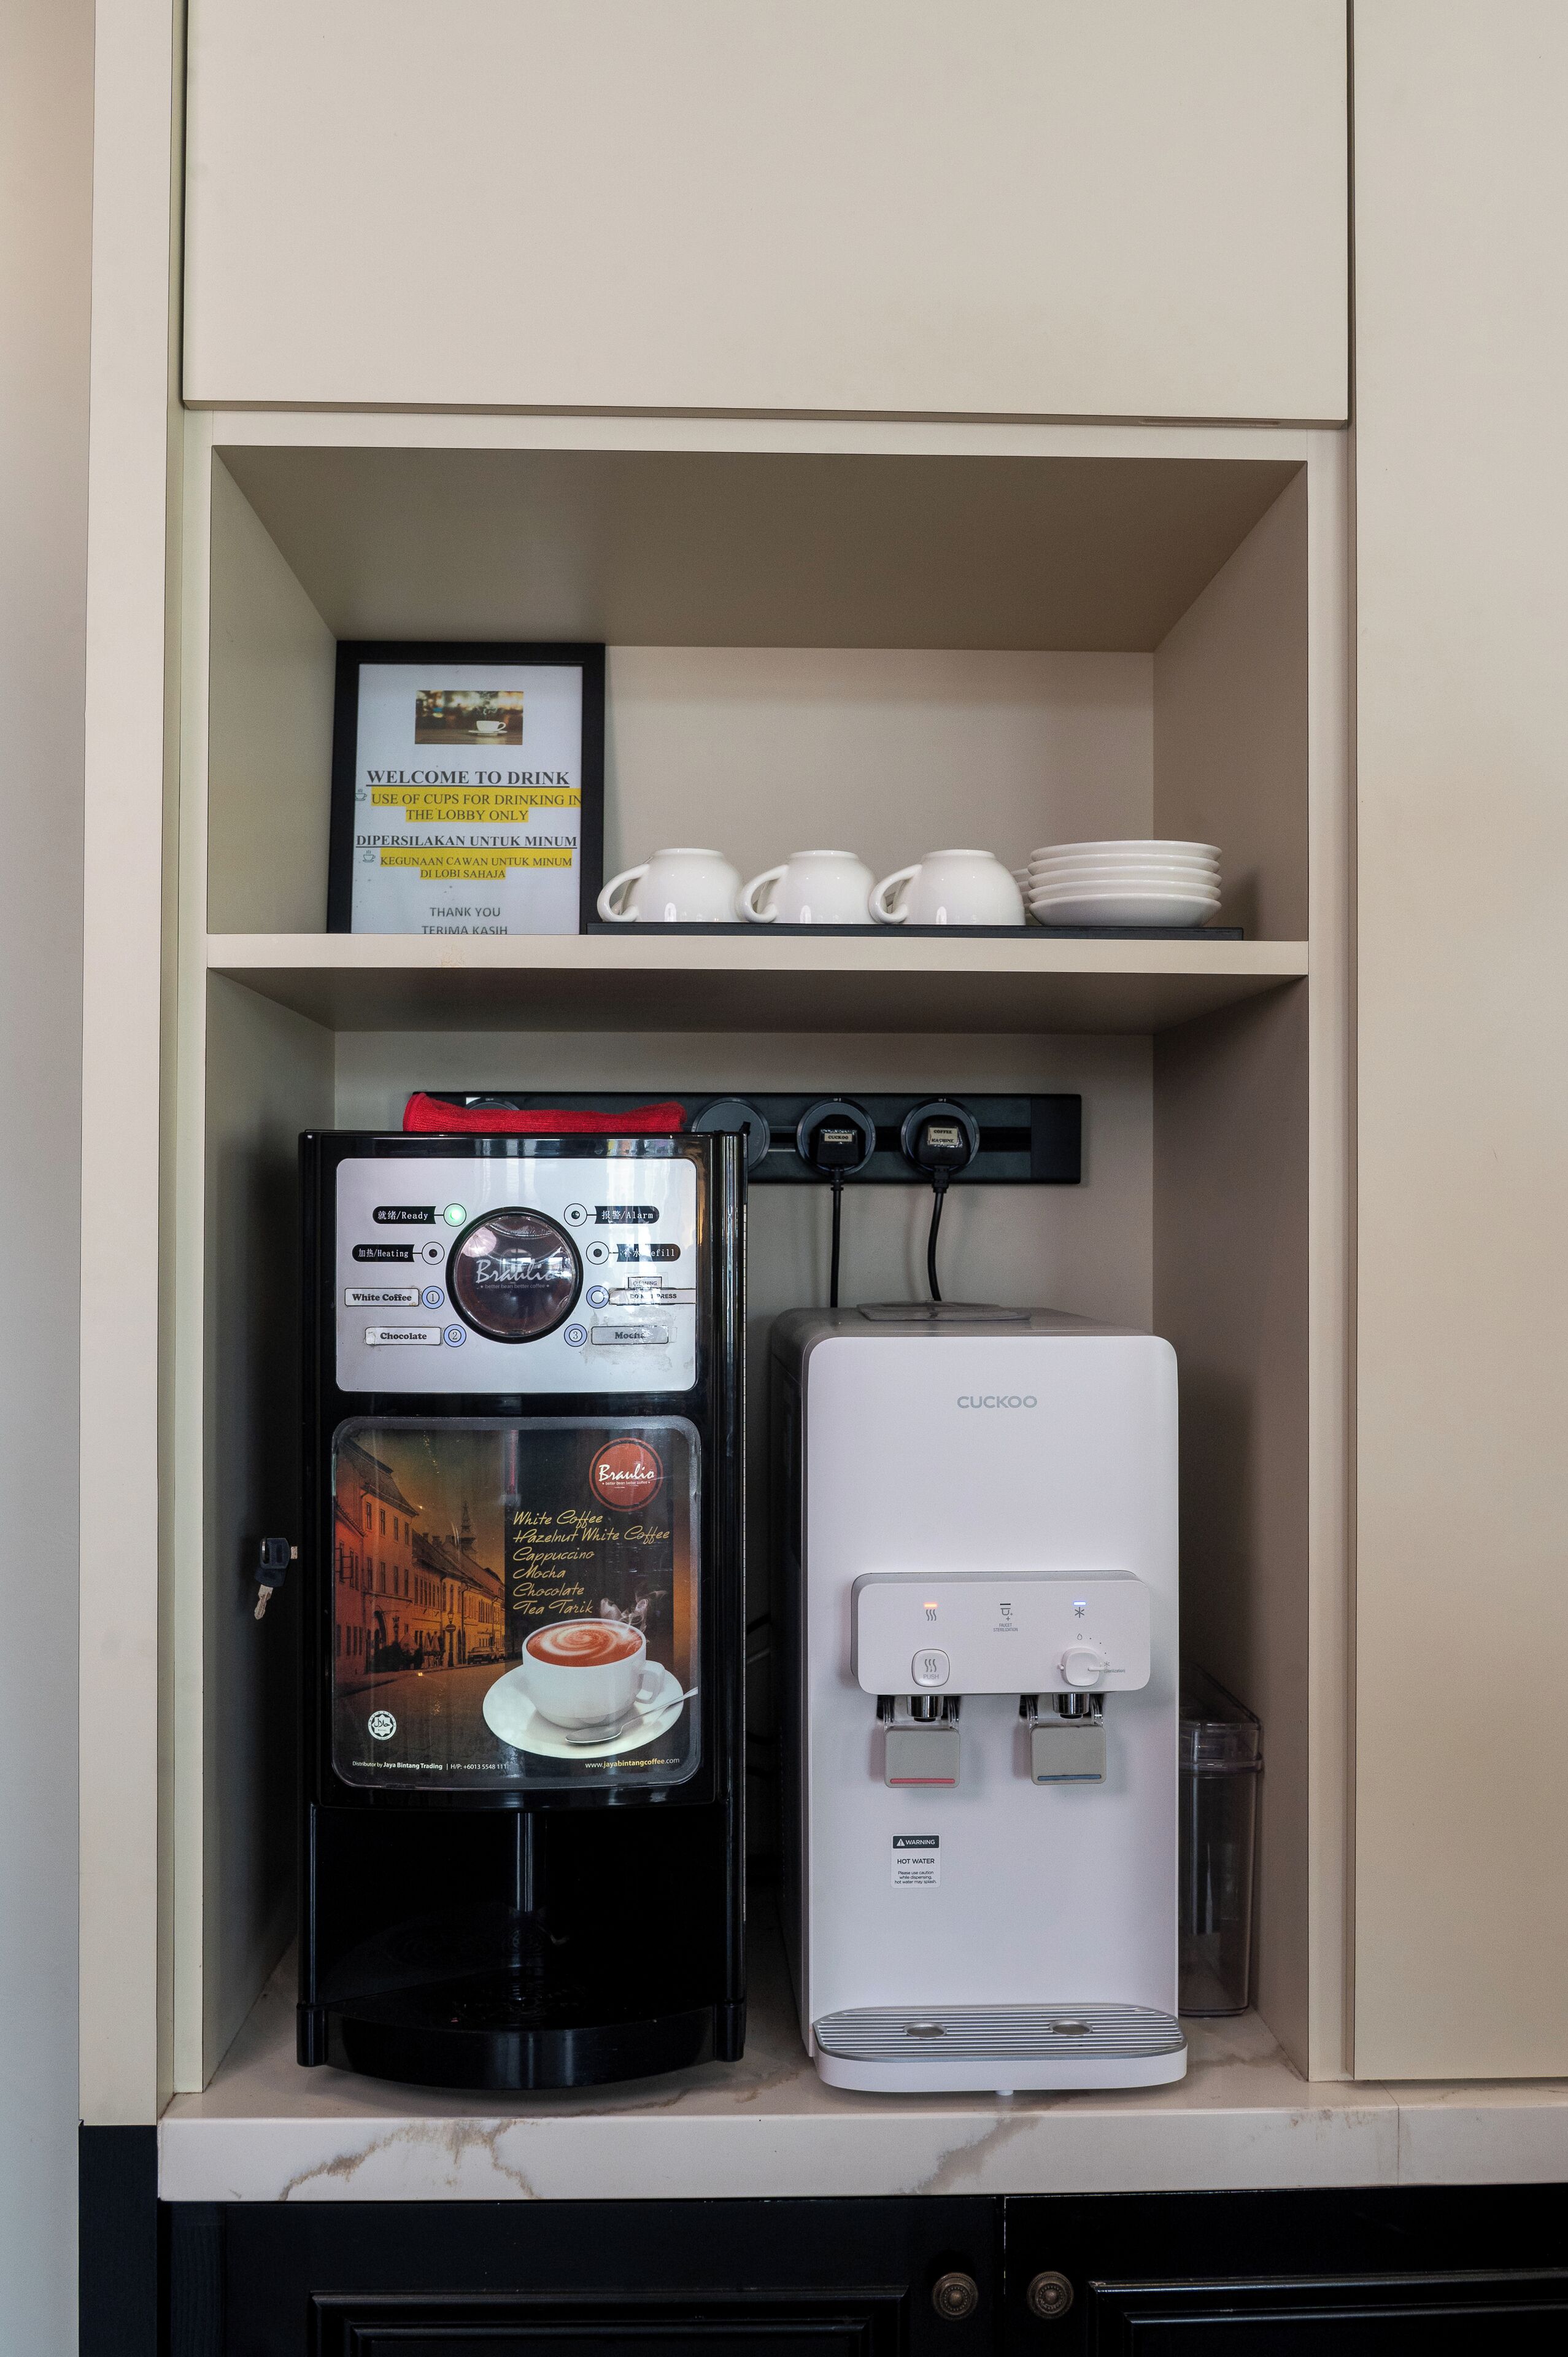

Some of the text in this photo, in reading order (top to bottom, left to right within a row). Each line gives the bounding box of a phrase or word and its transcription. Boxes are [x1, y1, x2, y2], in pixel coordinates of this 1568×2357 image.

[367, 770, 570, 785] WELCOME TO DRINK
[372, 794, 398, 804] USE
[402, 794, 420, 804] OF
[423, 794, 459, 805] CUPS
[463, 794, 490, 805] FOR
[495, 795, 565, 805] DRINKING
[406, 810, 529, 821] THE LOBBY ONLY
[357, 835, 577, 846] DIPERSILAKAN UNTUK MINUM
[380, 857, 444, 865] KEGUNAAN
[492, 857, 530, 866] UNTUK
[533, 857, 573, 866] MINUM
[463, 870, 506, 878] SAHAJA
[430, 907, 500, 917] THANK YOU
[422, 926, 507, 935] TERIMA KASIH
[377, 1210, 428, 1220] 就绪/Ready
[601, 1210, 654, 1220] 报警/Alarm
[358, 1248, 409, 1258] 加热/Heating
[431, 1293, 435, 1302] 1
[573, 1331, 578, 1340] 3
[957, 1395, 1038, 1409] CUCKOO
[599, 1463, 655, 1482] Braulio
[513, 1509, 603, 1529] White Coffee
[513, 1525, 670, 1545] Hazelnut White Coffee
[512, 1546, 595, 1565] Cappuccino
[512, 1565, 566, 1579] Mocha
[513, 1582, 584, 1596] Chocolate
[513, 1599, 593, 1615] Tea Tarik
[585, 1758, 680, 1769] www.jayabintangcoffee.com
